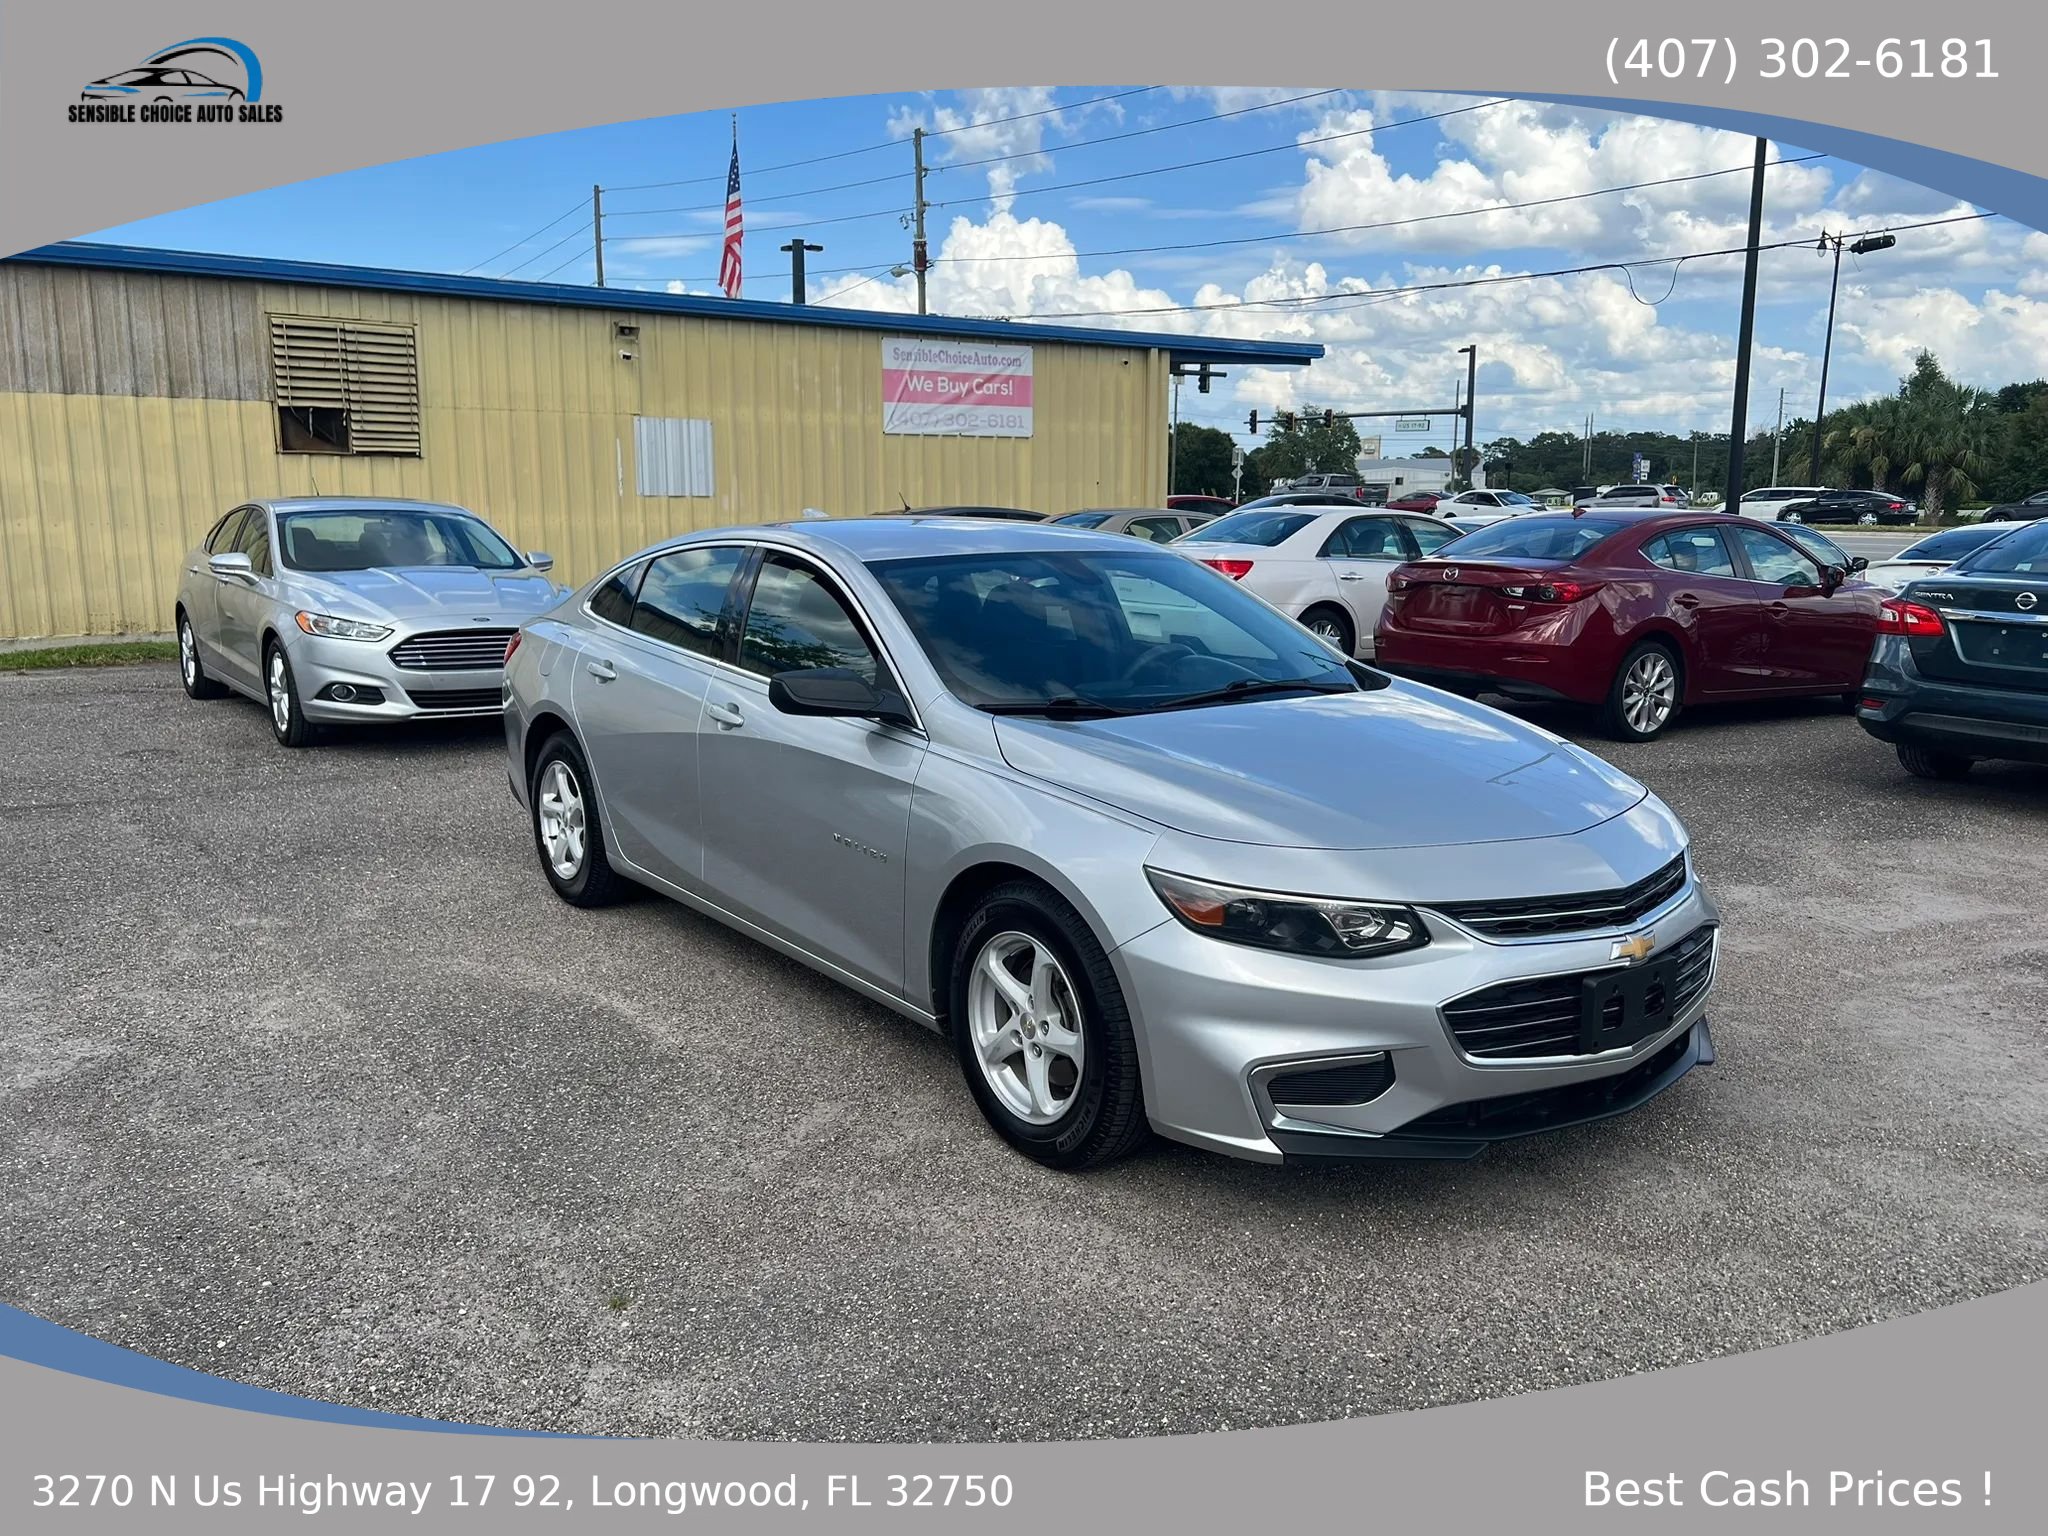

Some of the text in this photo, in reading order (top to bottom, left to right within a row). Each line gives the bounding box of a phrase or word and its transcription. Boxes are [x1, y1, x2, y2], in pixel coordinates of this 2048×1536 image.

[893, 347, 1022, 368] SensibleChoiceAuto.com
[907, 375, 1013, 398] We Buy Cars!
[943, 413, 1025, 429] 302-6181
